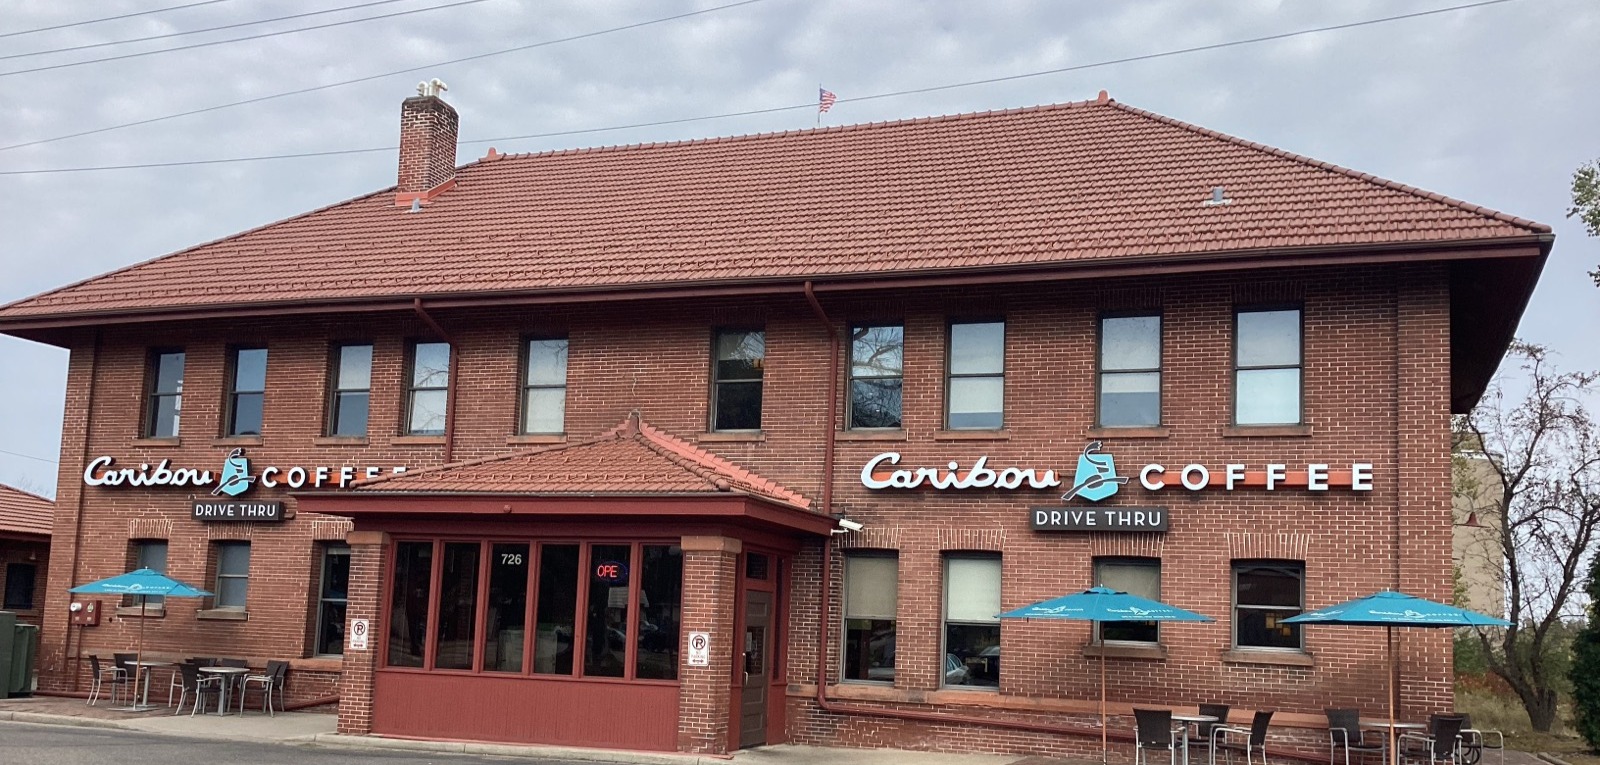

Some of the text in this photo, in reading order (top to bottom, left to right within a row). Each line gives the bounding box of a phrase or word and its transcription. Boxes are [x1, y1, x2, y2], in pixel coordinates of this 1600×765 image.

[84, 455, 213, 486] Caribou
[860, 452, 1373, 491] Caribou COFFEE
[195, 504, 277, 517] DRIVE THRU
[1035, 510, 1162, 527] DRIVE THRU
[501, 553, 522, 565] 726
